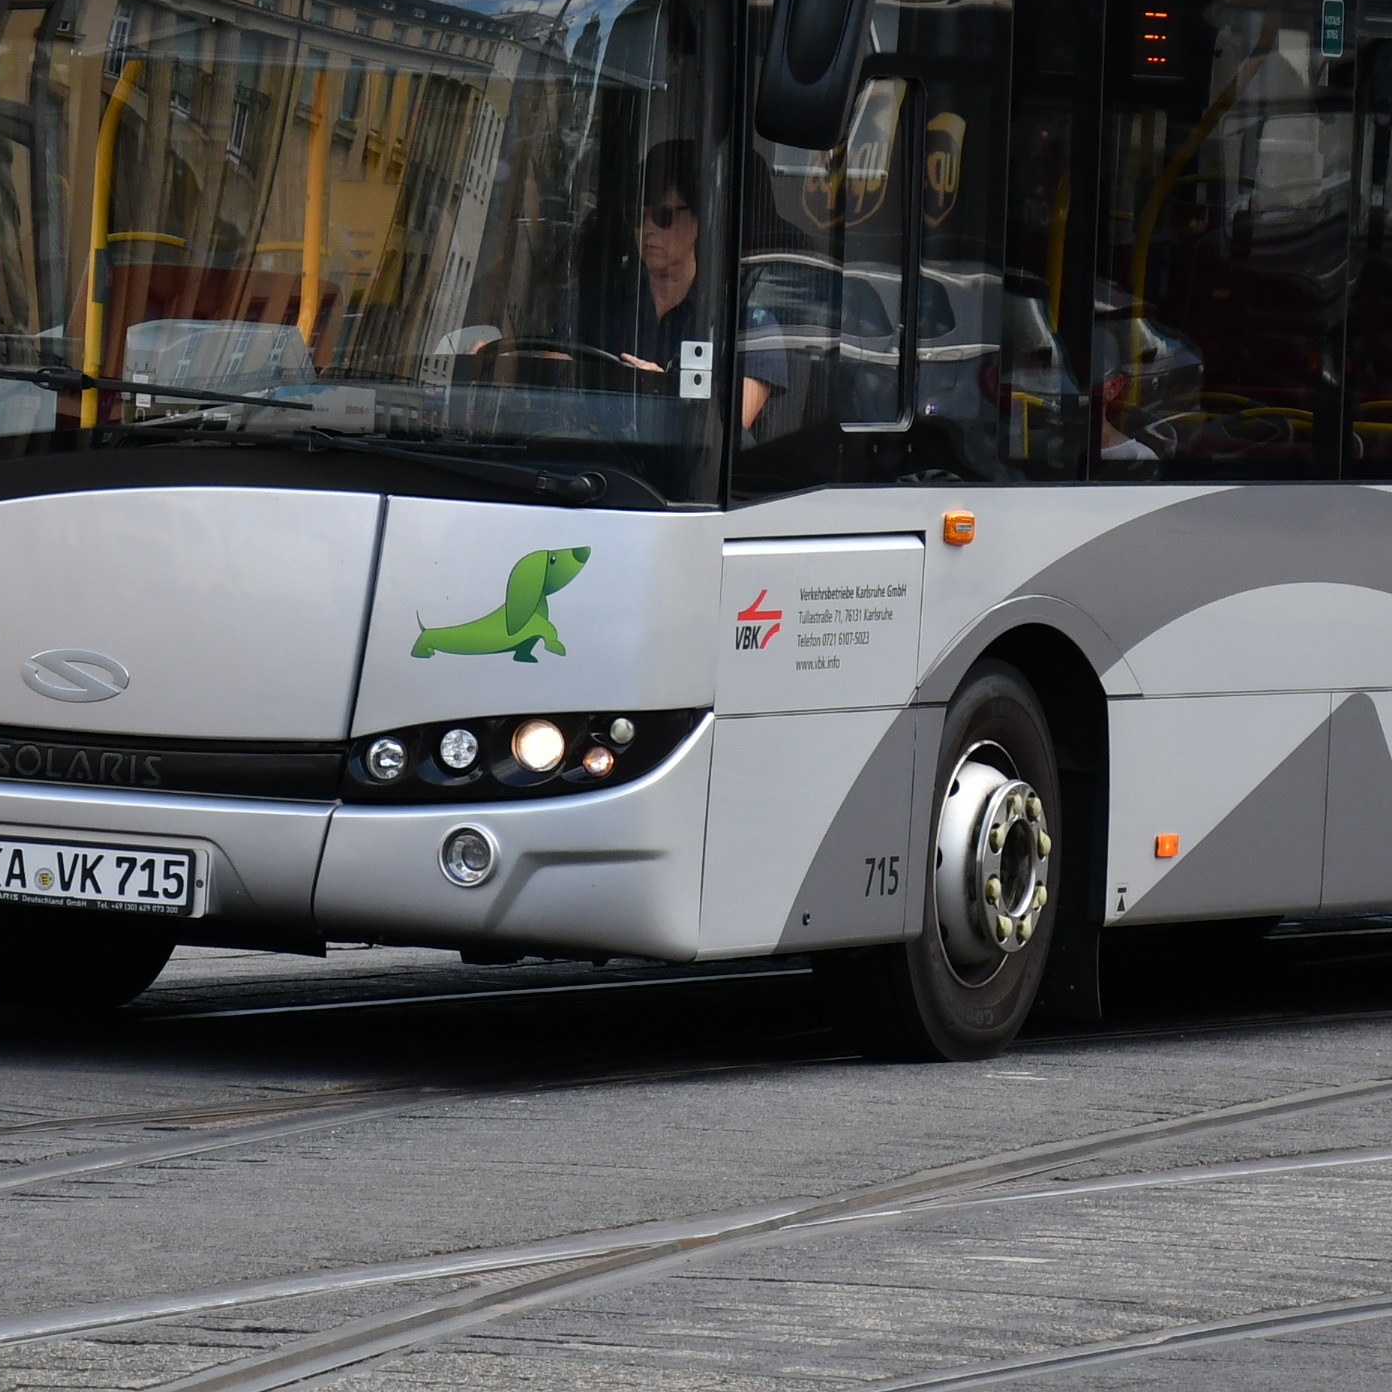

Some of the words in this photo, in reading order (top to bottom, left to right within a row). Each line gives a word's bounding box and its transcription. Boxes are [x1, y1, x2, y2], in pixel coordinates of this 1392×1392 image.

[799, 586, 854, 601] Verkehrsbetriebe
[855, 584, 886, 599] Karlsruhe
[886, 584, 907, 598] GmbH
[834, 609, 843, 624] 71,
[844, 608, 862, 623] 76131
[863, 607, 893, 621] Karlsruhe
[735, 625, 761, 650] VBK
[797, 633, 821, 647] Telefon
[821, 632, 837, 647] 0721
[795, 655, 841, 671] www.vbk.info
[56, 851, 105, 895] VK
[115, 855, 186, 900] 715
[864, 855, 900, 897] 715
[21, 894, 64, 906] Deutschland
[66, 899, 87, 908] GmbH
[152, 905, 165, 913] 073
